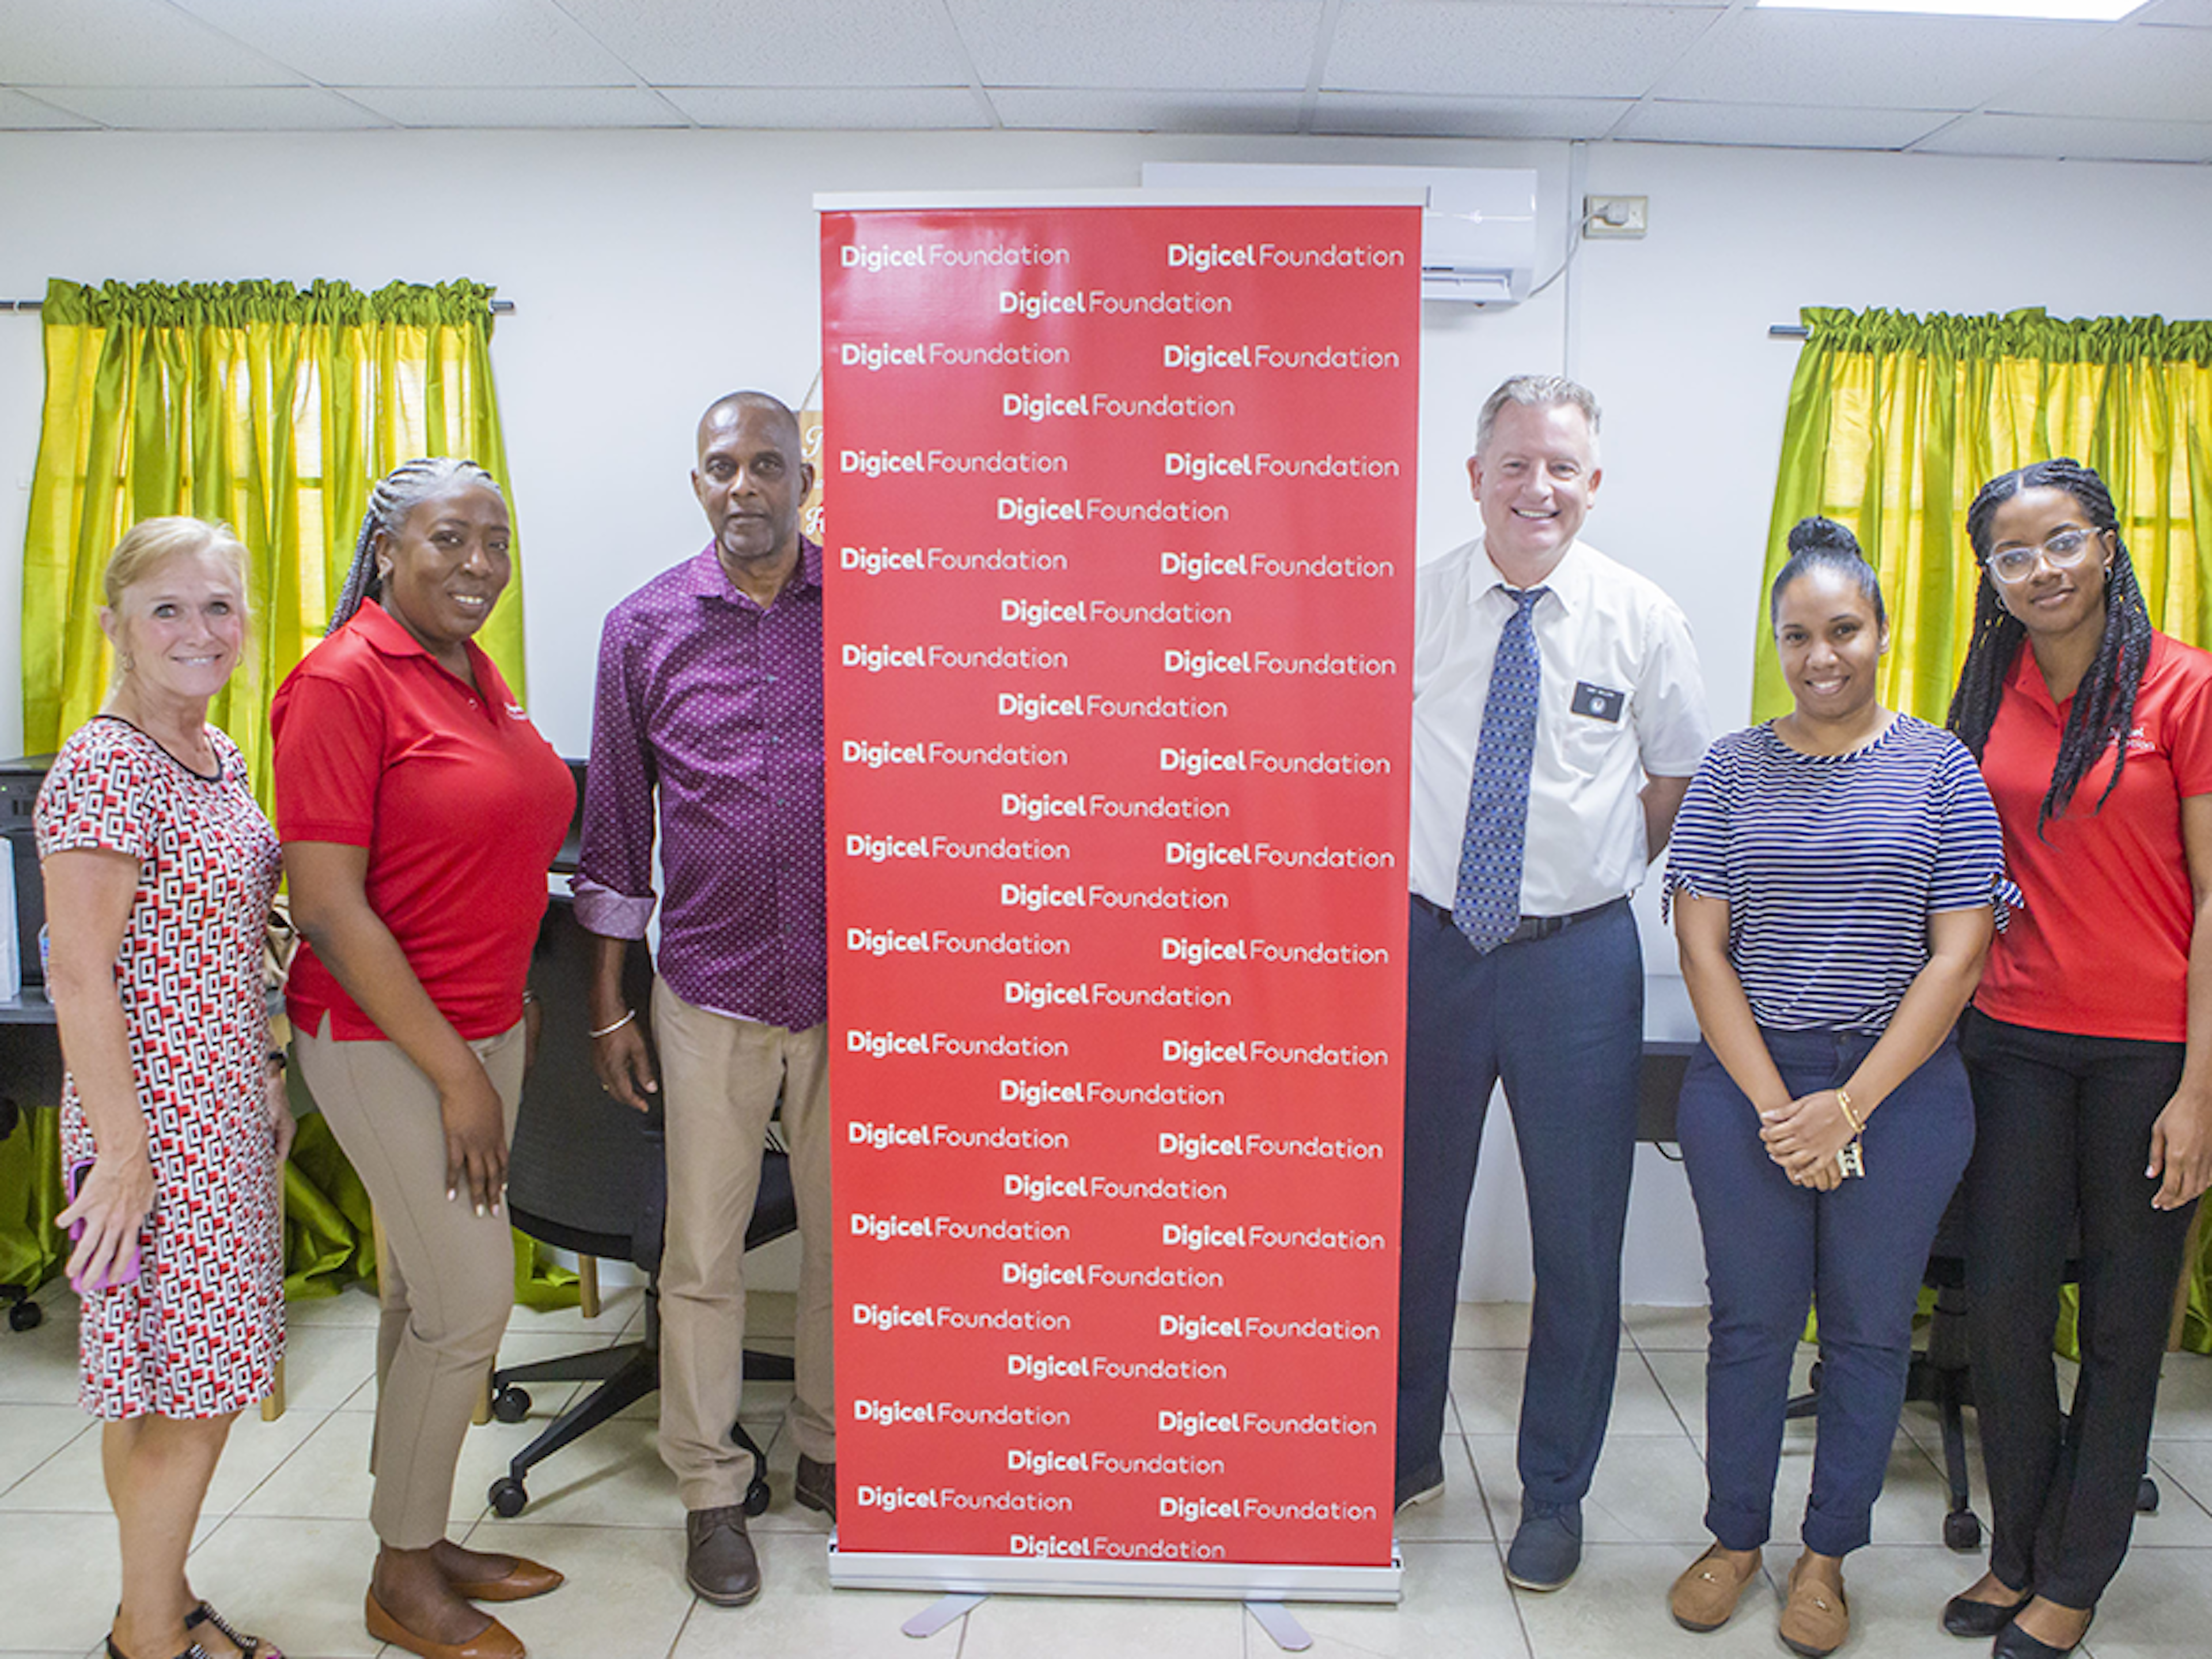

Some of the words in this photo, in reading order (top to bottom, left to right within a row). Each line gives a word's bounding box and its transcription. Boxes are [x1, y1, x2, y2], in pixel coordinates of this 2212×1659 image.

[843, 245, 926, 272] Digicel
[930, 244, 1070, 266] Foundation
[1168, 243, 1257, 272] Digicel
[1259, 244, 1404, 267] Foundation
[999, 290, 1086, 319] Digicel
[1089, 290, 1232, 314] Foundation
[842, 342, 926, 371] Digicel
[930, 343, 1070, 365] Foundation
[1164, 344, 1252, 373] Digicel
[1255, 344, 1399, 369] Foundation
[1003, 392, 1089, 422] Digicel
[1092, 393, 1235, 417] Foundation
[840, 449, 925, 478] Digicel
[927, 450, 1067, 473] Foundation
[1165, 452, 1253, 481] Digicel
[1255, 453, 1399, 478] Foundation
[997, 497, 1084, 527] Digicel
[1086, 498, 1229, 522] Foundation
[840, 547, 925, 575] Digicel
[927, 547, 1067, 570] Foundation
[1161, 552, 1248, 581] Digicel
[1251, 554, 1394, 577] Foundation
[1001, 599, 1088, 628] Digicel
[1090, 600, 1232, 623] Foundation
[842, 643, 926, 672] Digicel
[928, 645, 1068, 669] Foundation
[1164, 649, 1252, 679] Digicel
[1254, 651, 1396, 676] Foundation
[998, 692, 1084, 721] Digicel
[1086, 694, 1228, 718] Foundation
[842, 740, 926, 768] Digicel
[928, 742, 1068, 766] Foundation
[1160, 747, 1247, 776] Digicel
[1250, 749, 1391, 775] Foundation
[1001, 793, 1087, 821] Digicel
[1089, 794, 1230, 819] Foundation
[846, 834, 930, 863] Digicel
[932, 836, 1070, 860] Foundation
[1165, 842, 1252, 870] Digicel
[1255, 843, 1395, 869] Foundation
[1001, 883, 1086, 912] Digicel
[1089, 885, 1229, 909] Foundation
[847, 927, 930, 957] Digicel
[932, 930, 1070, 955] Foundation
[1161, 937, 1248, 966] Digicel
[1250, 939, 1389, 964] Foundation
[1005, 981, 1090, 1009] Digicel
[1092, 983, 1232, 1007] Foundation
[847, 1029, 930, 1059] Digicel
[932, 1032, 1069, 1057] Foundation
[1162, 1040, 1248, 1068] Digicel
[1250, 1040, 1388, 1066] Foundation
[1000, 1079, 1085, 1107] Digicel
[1086, 1082, 1225, 1105] Foundation
[849, 1121, 931, 1150] Digicel
[933, 1124, 1069, 1149] Foundation
[1158, 1132, 1244, 1160] Digicel
[1245, 1134, 1383, 1160] Foundation
[1004, 1174, 1089, 1202] Digicel
[1091, 1176, 1227, 1200] Foundation
[851, 1213, 934, 1241] Digicel
[935, 1216, 1070, 1241] Foundation
[1162, 1224, 1247, 1251] Digicel
[1248, 1225, 1385, 1250] Foundation
[1002, 1262, 1086, 1289] Digicel
[1088, 1264, 1224, 1287] Foundation
[853, 1303, 935, 1331] Digicel
[937, 1306, 1071, 1331] Foundation
[1160, 1314, 1243, 1341] Digicel
[1245, 1317, 1380, 1340] Foundation
[1007, 1354, 1090, 1381] Digicel
[1092, 1357, 1227, 1379] Foundation
[854, 1399, 935, 1426] Digicel
[937, 1402, 1070, 1426] Foundation
[1158, 1410, 1241, 1437] Digicel
[1243, 1412, 1377, 1435] Foundation
[1007, 1449, 1089, 1476] Digicel
[1091, 1451, 1225, 1475] Foundation
[858, 1485, 938, 1512] Digicel
[940, 1488, 1073, 1512] Foundation
[1160, 1497, 1241, 1522] Digicel
[1244, 1498, 1376, 1521] Foundation
[1010, 1535, 1090, 1558] Digicel
[1093, 1537, 1225, 1558] Foundation
